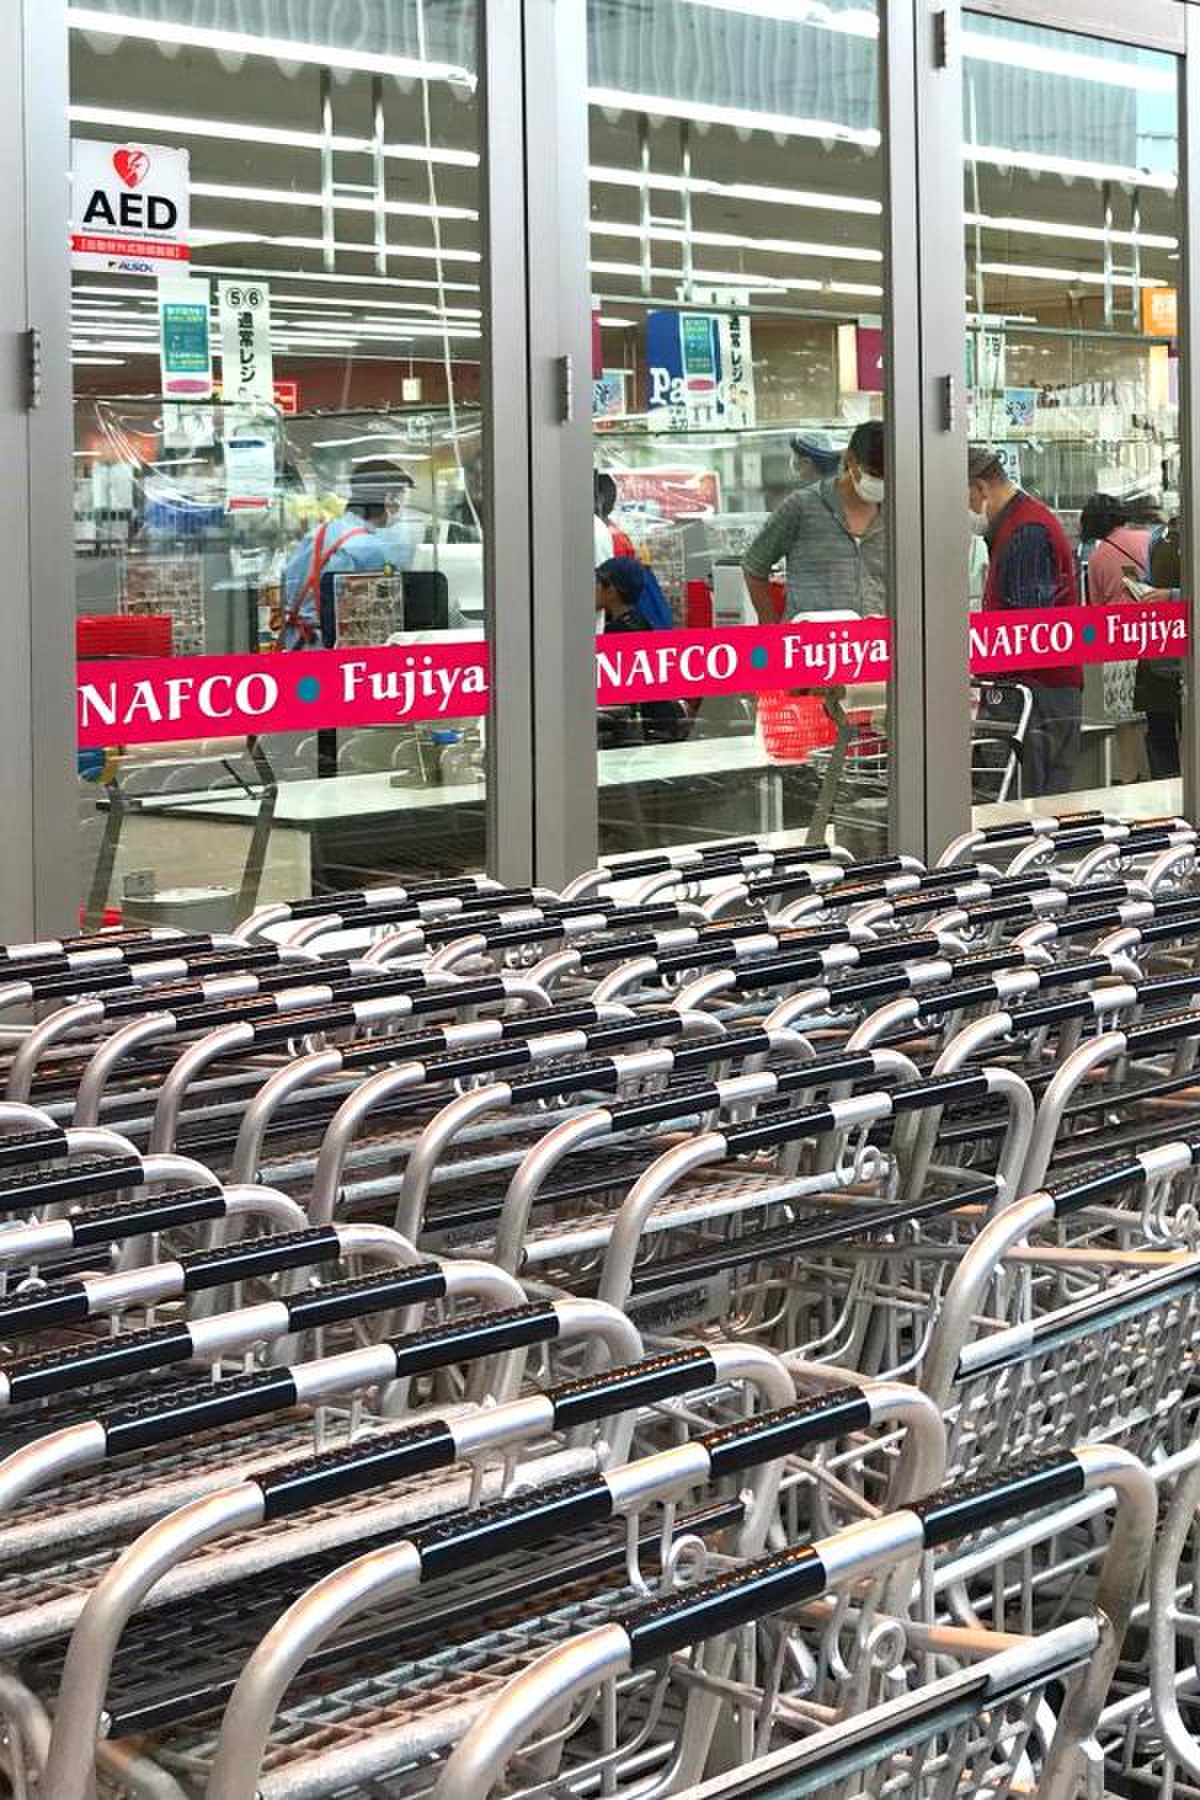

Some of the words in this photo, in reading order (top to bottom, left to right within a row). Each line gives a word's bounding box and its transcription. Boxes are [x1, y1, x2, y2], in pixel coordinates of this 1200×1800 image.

[83, 190, 177, 230] AED
[595, 643, 738, 688] NAFCO
[781, 631, 890, 681] Fujiya
[968, 621, 1073, 659] NAFCO
[1105, 611, 1187, 655] Fujiya
[76, 672, 279, 728] NAFCO
[338, 656, 489, 716] Fujiya
